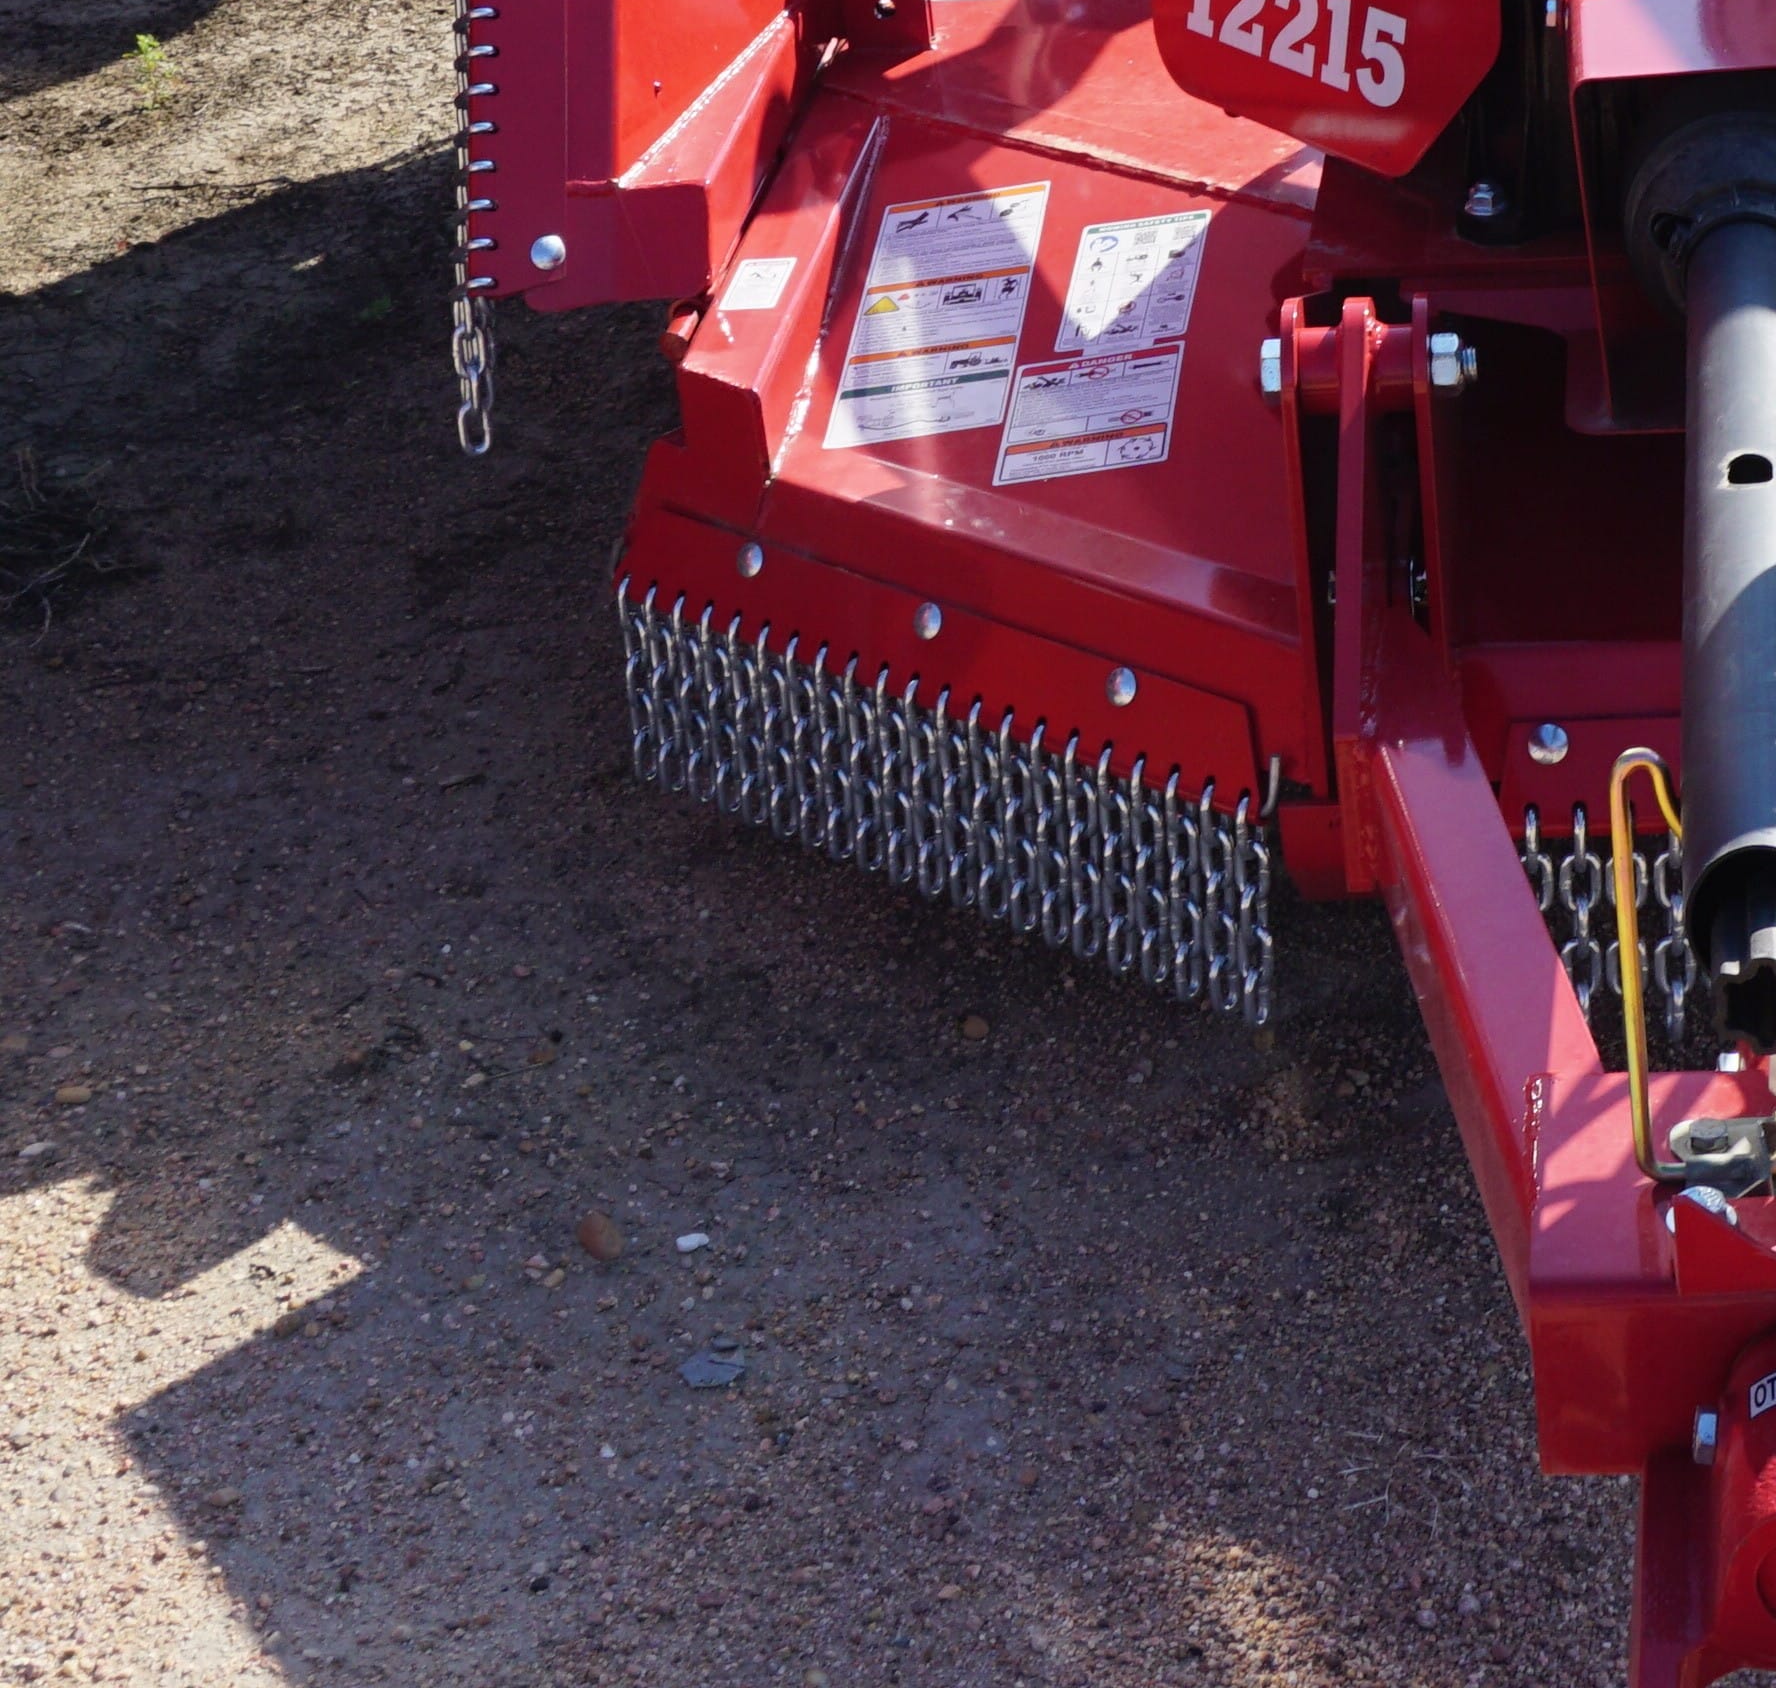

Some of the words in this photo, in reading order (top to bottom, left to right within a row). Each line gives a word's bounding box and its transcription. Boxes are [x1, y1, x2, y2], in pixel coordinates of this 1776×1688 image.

[927, 272, 984, 286] WARNING
[912, 343, 969, 356] WARNING
[1081, 354, 1133, 368] DANGER
[891, 377, 960, 393] IMPORTANT
[1062, 430, 1124, 446] WARNING
[1059, 448, 1085, 459] RPM
